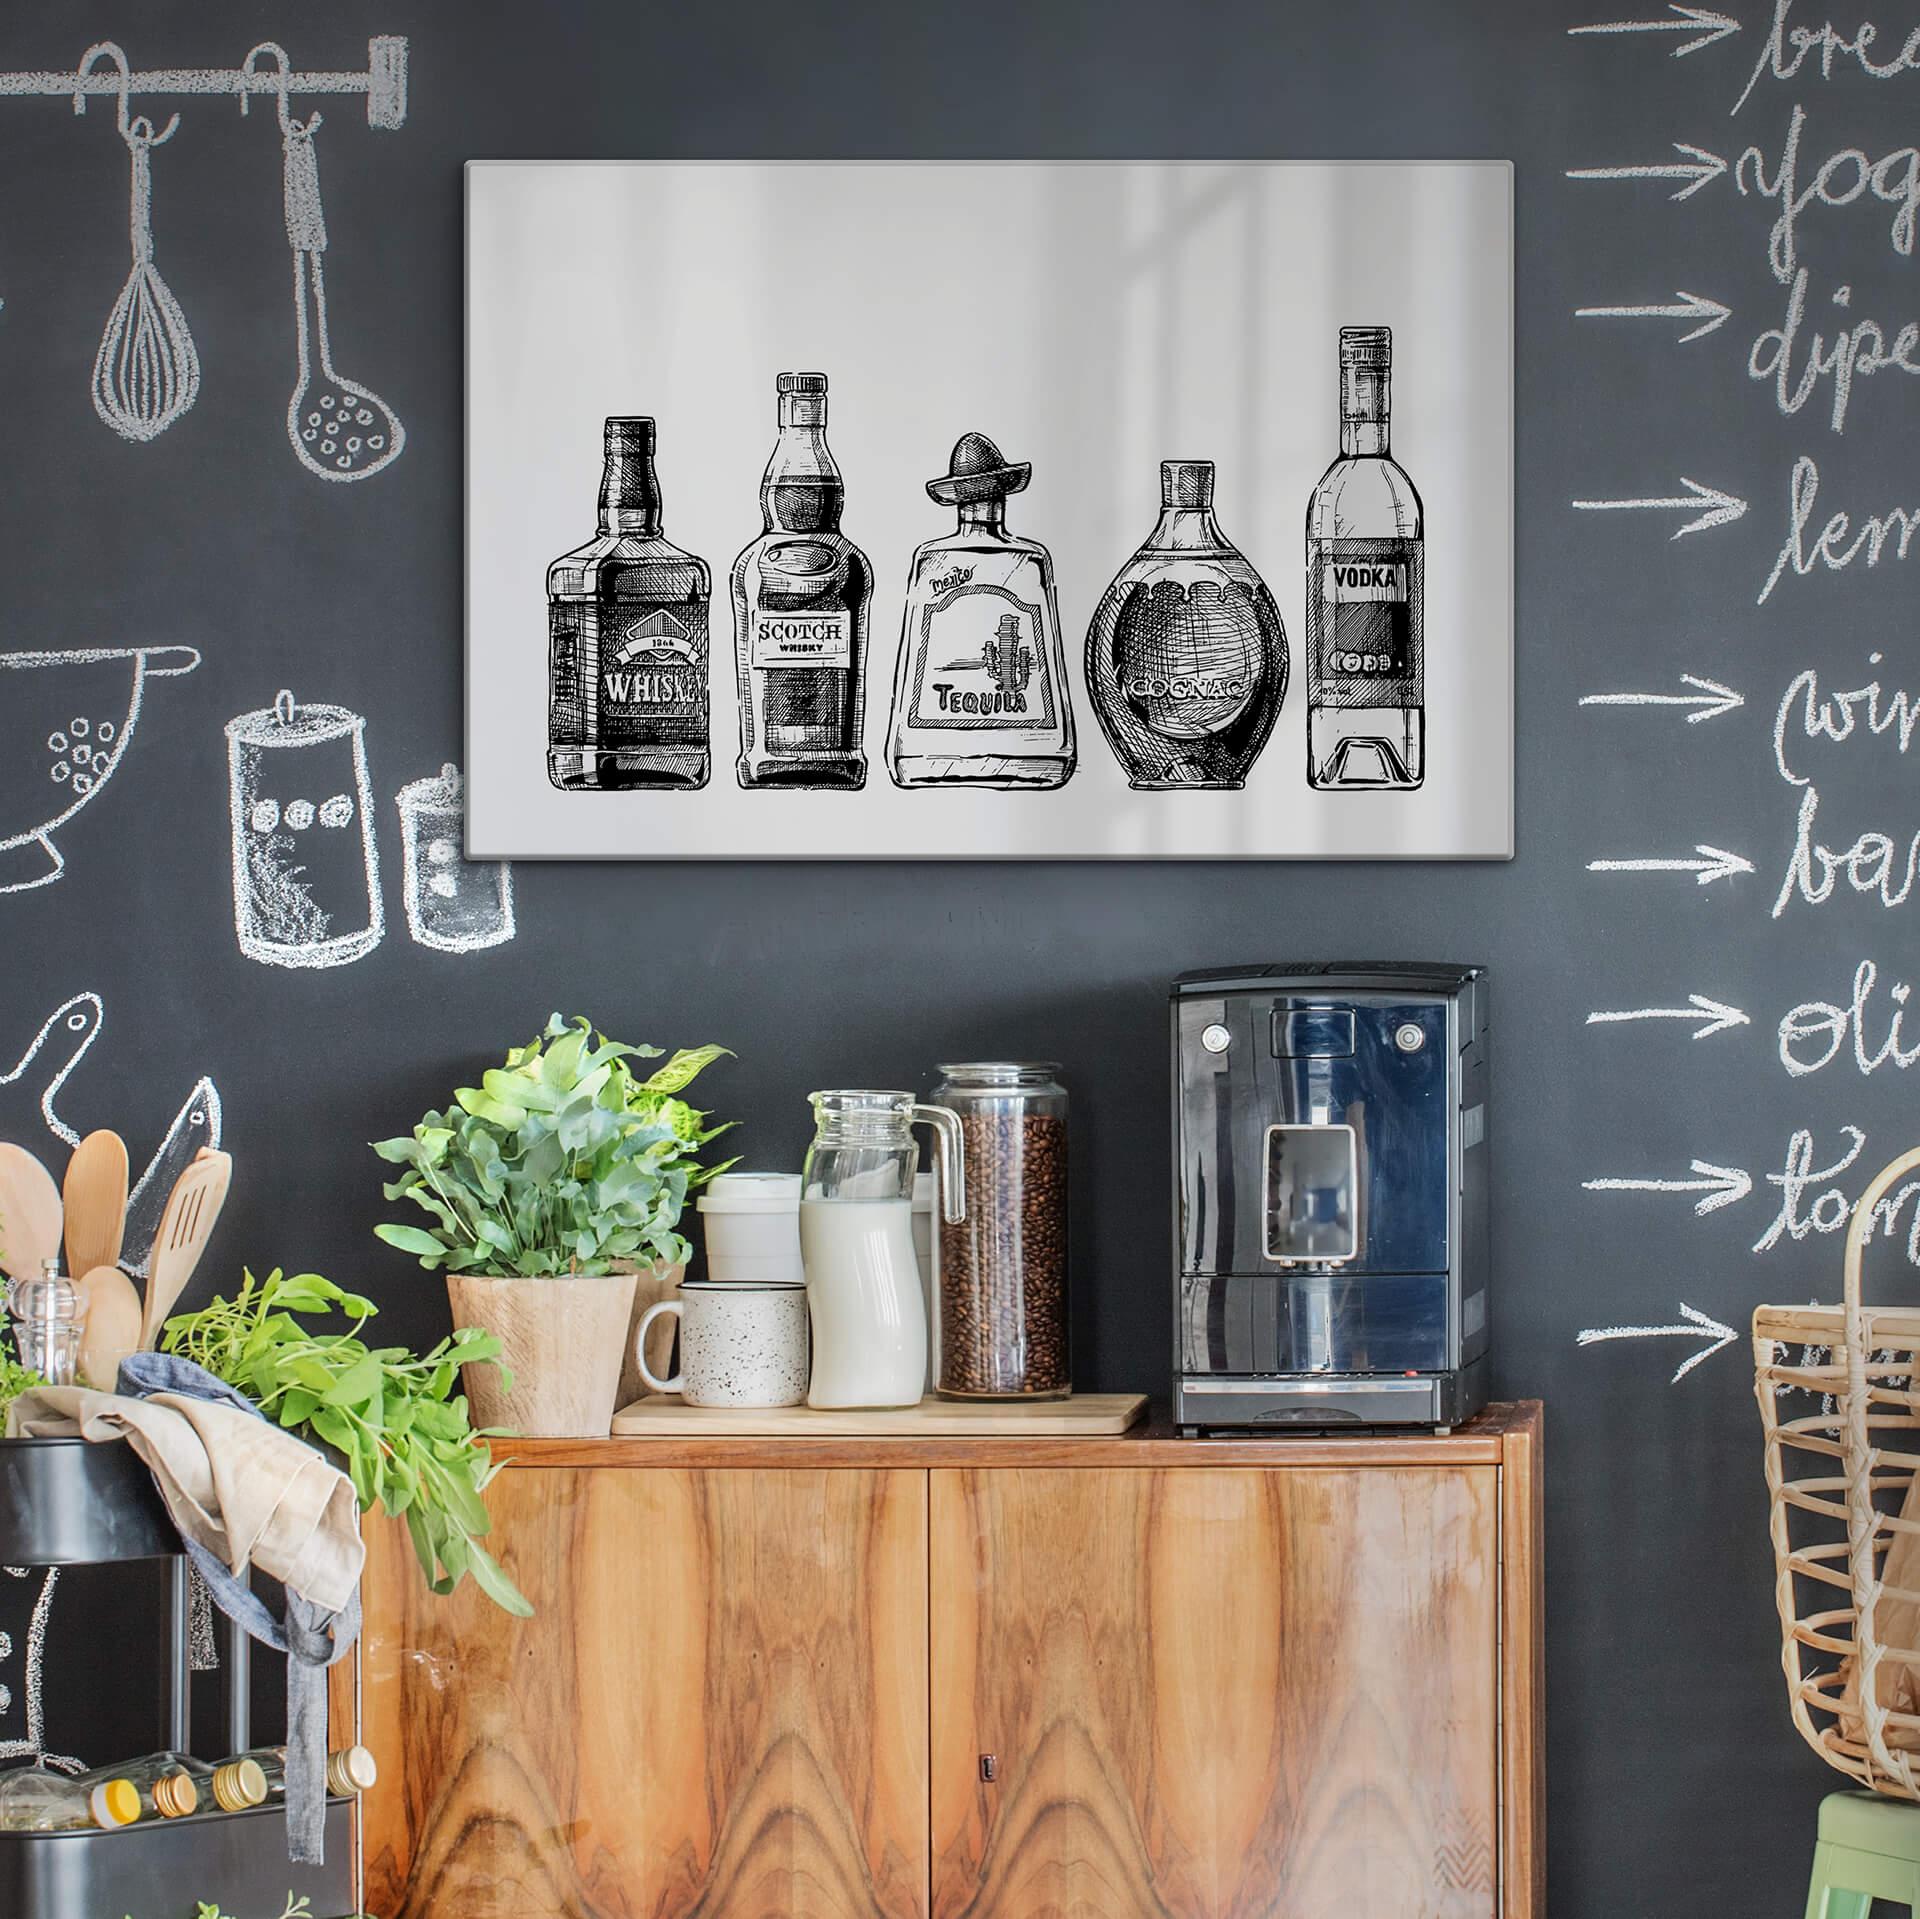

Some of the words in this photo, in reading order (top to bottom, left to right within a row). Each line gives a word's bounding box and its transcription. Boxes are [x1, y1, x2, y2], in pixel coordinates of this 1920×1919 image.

[1749, 266, 1920, 436] dipe
[1333, 566, 1397, 588] VODKA
[759, 620, 842, 643] SCOTCH
[779, 643, 824, 653] WHISKY
[932, 683, 1028, 716] TEQUILA
[1130, 679, 1245, 700] COGNAC
[1778, 959, 1920, 1078] oli
